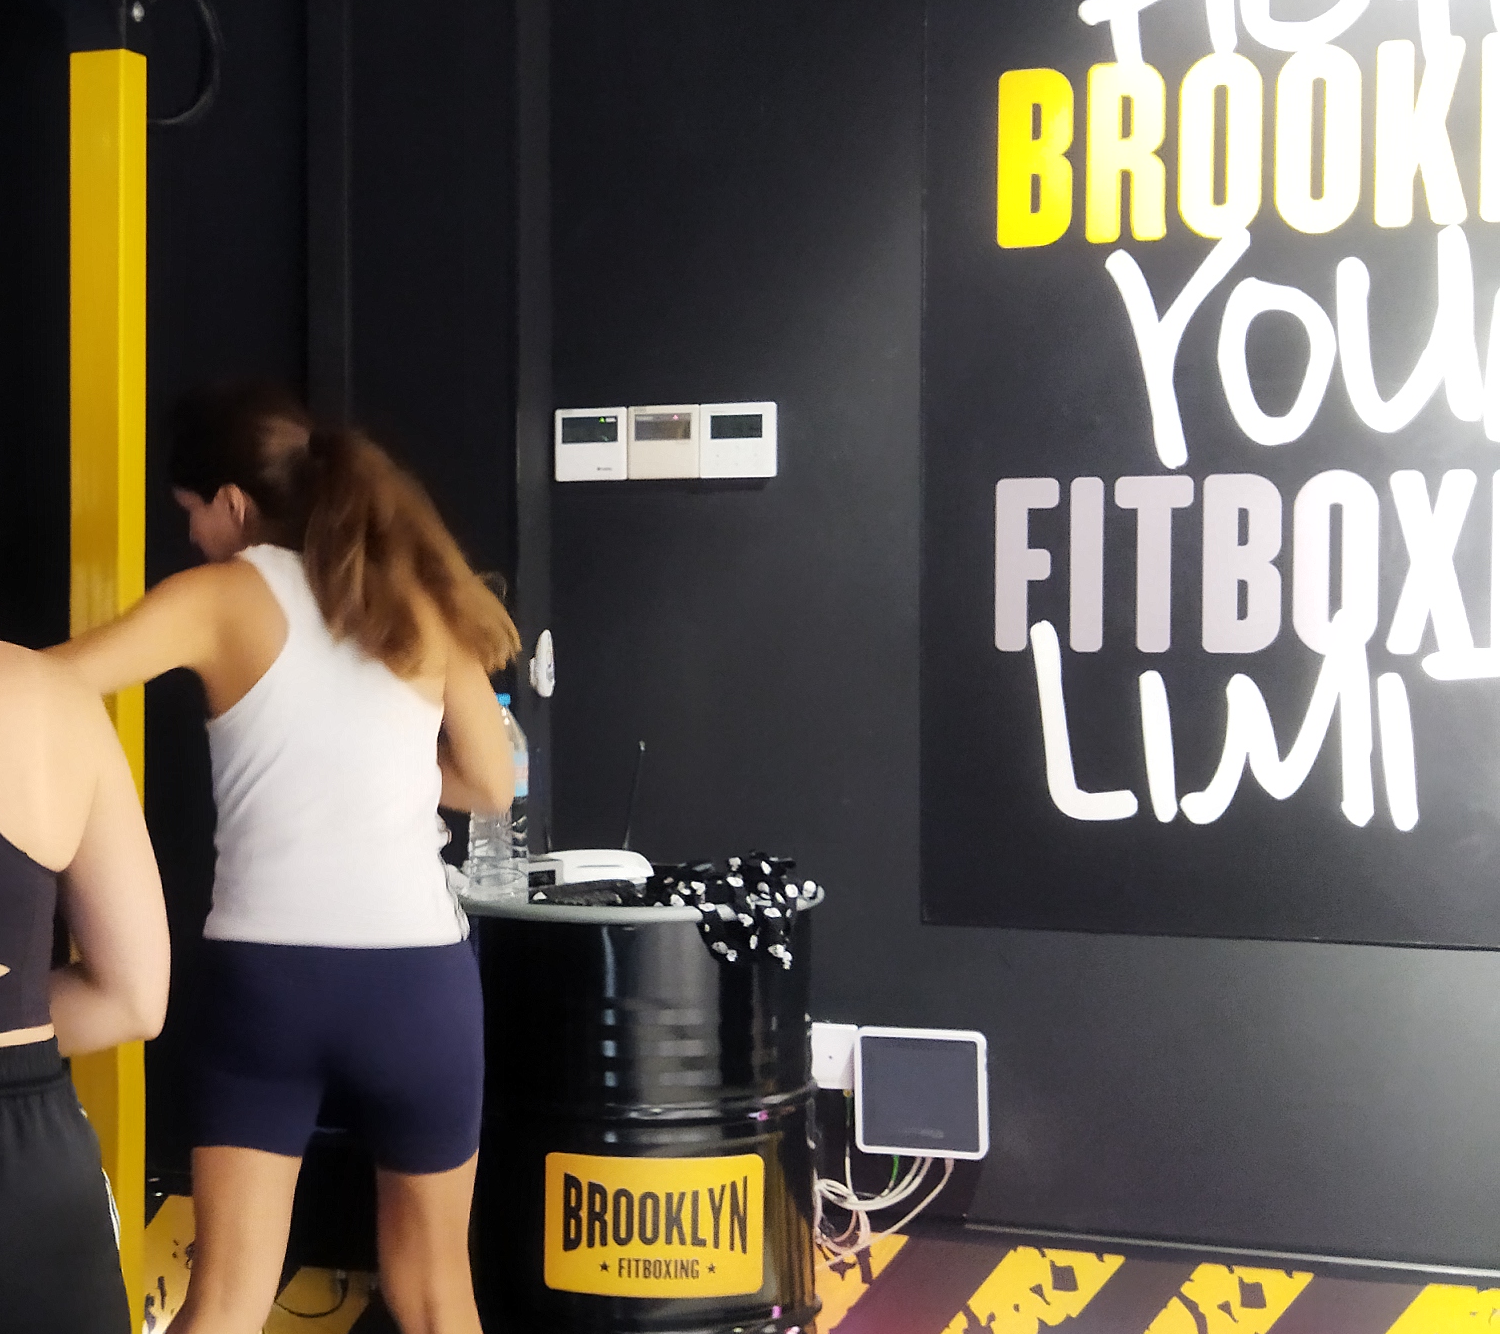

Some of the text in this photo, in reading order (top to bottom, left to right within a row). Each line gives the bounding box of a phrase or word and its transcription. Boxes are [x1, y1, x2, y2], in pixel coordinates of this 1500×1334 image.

[997, 33, 1500, 248] BROOK
[1104, 225, 1500, 468] YOU
[994, 469, 1500, 654] FITBOX
[563, 1173, 748, 1254] BROOKLYN
[617, 1258, 700, 1280] FITBOXING
